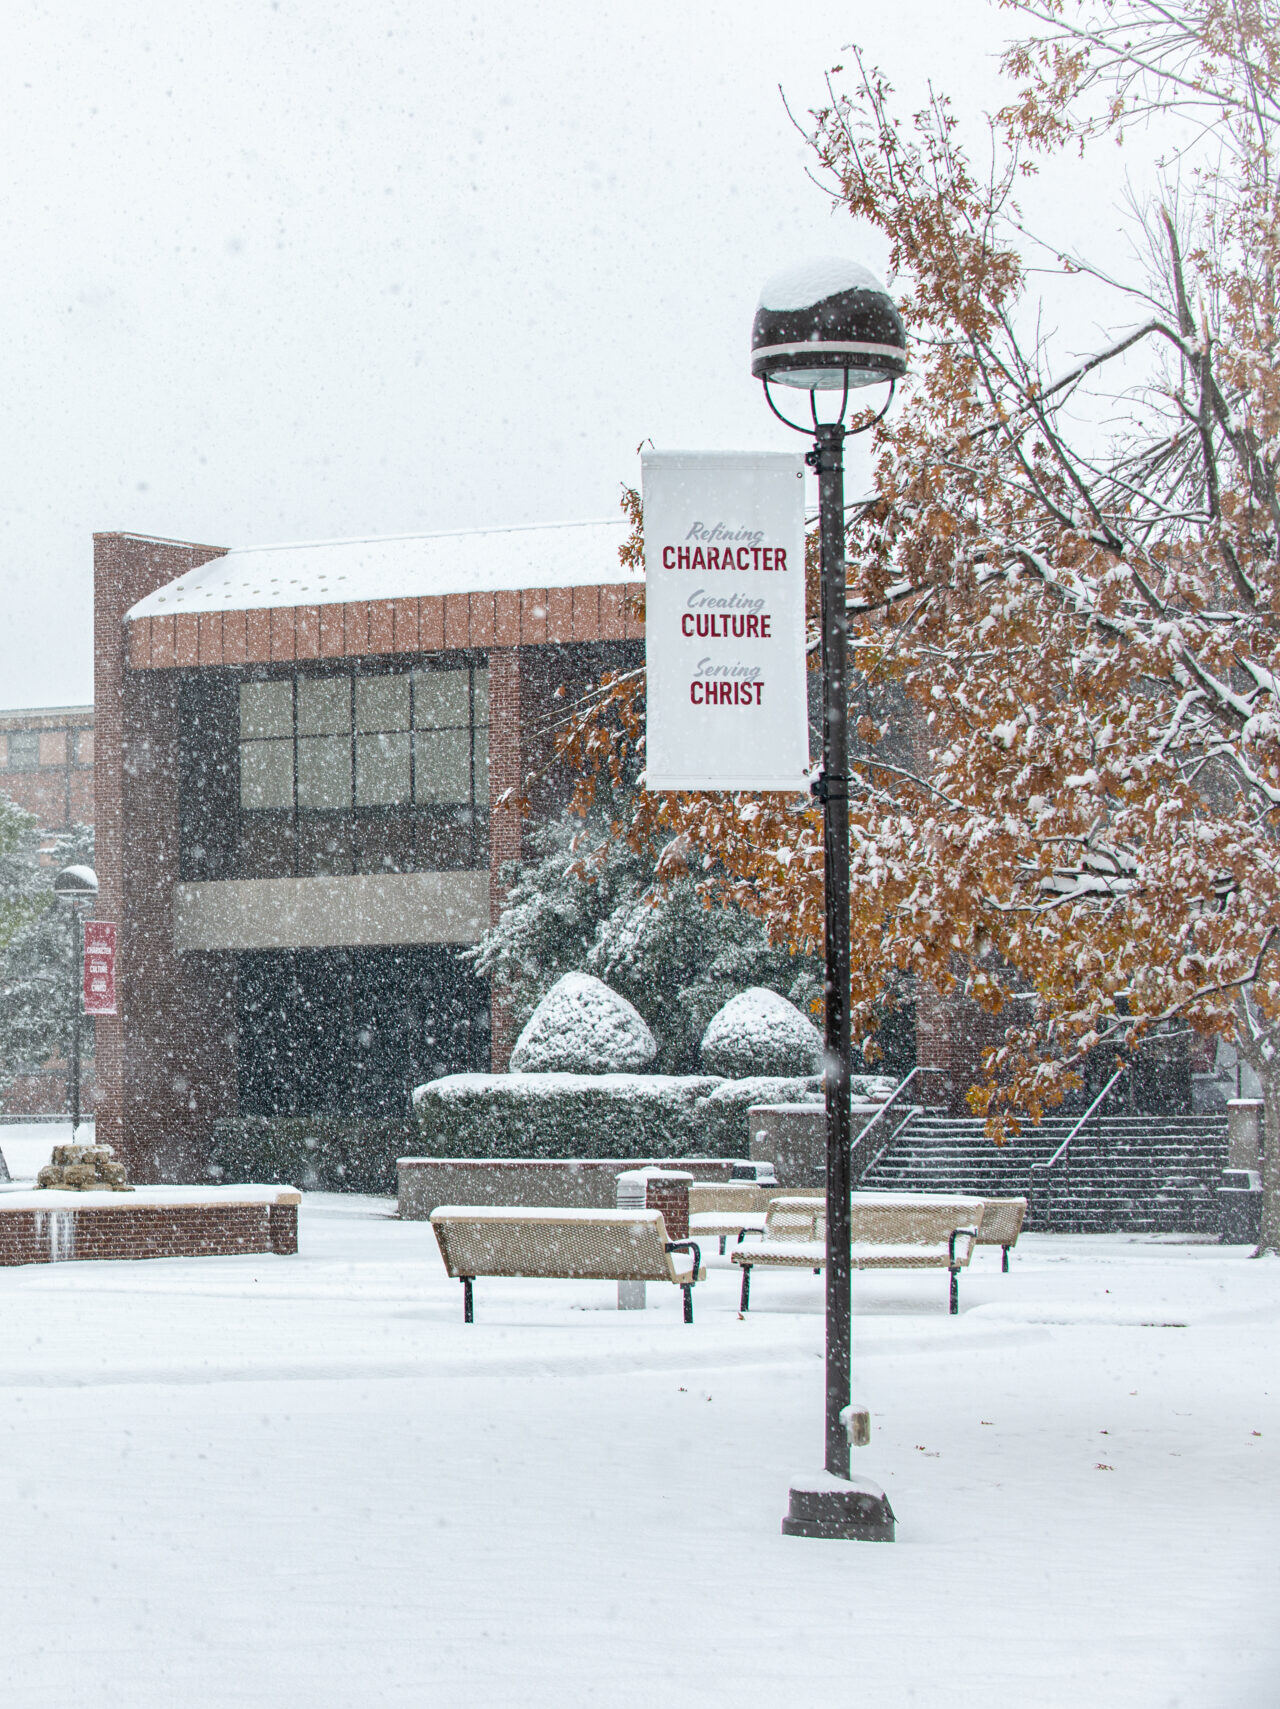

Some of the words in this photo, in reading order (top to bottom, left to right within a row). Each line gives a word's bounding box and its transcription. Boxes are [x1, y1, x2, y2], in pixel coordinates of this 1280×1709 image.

[686, 521, 765, 546] Refining
[662, 546, 787, 571] CHARACTER
[686, 589, 766, 614] Creating
[682, 613, 771, 638] CULTURE
[693, 657, 761, 682] Serving
[690, 681, 764, 705] CHRIST
